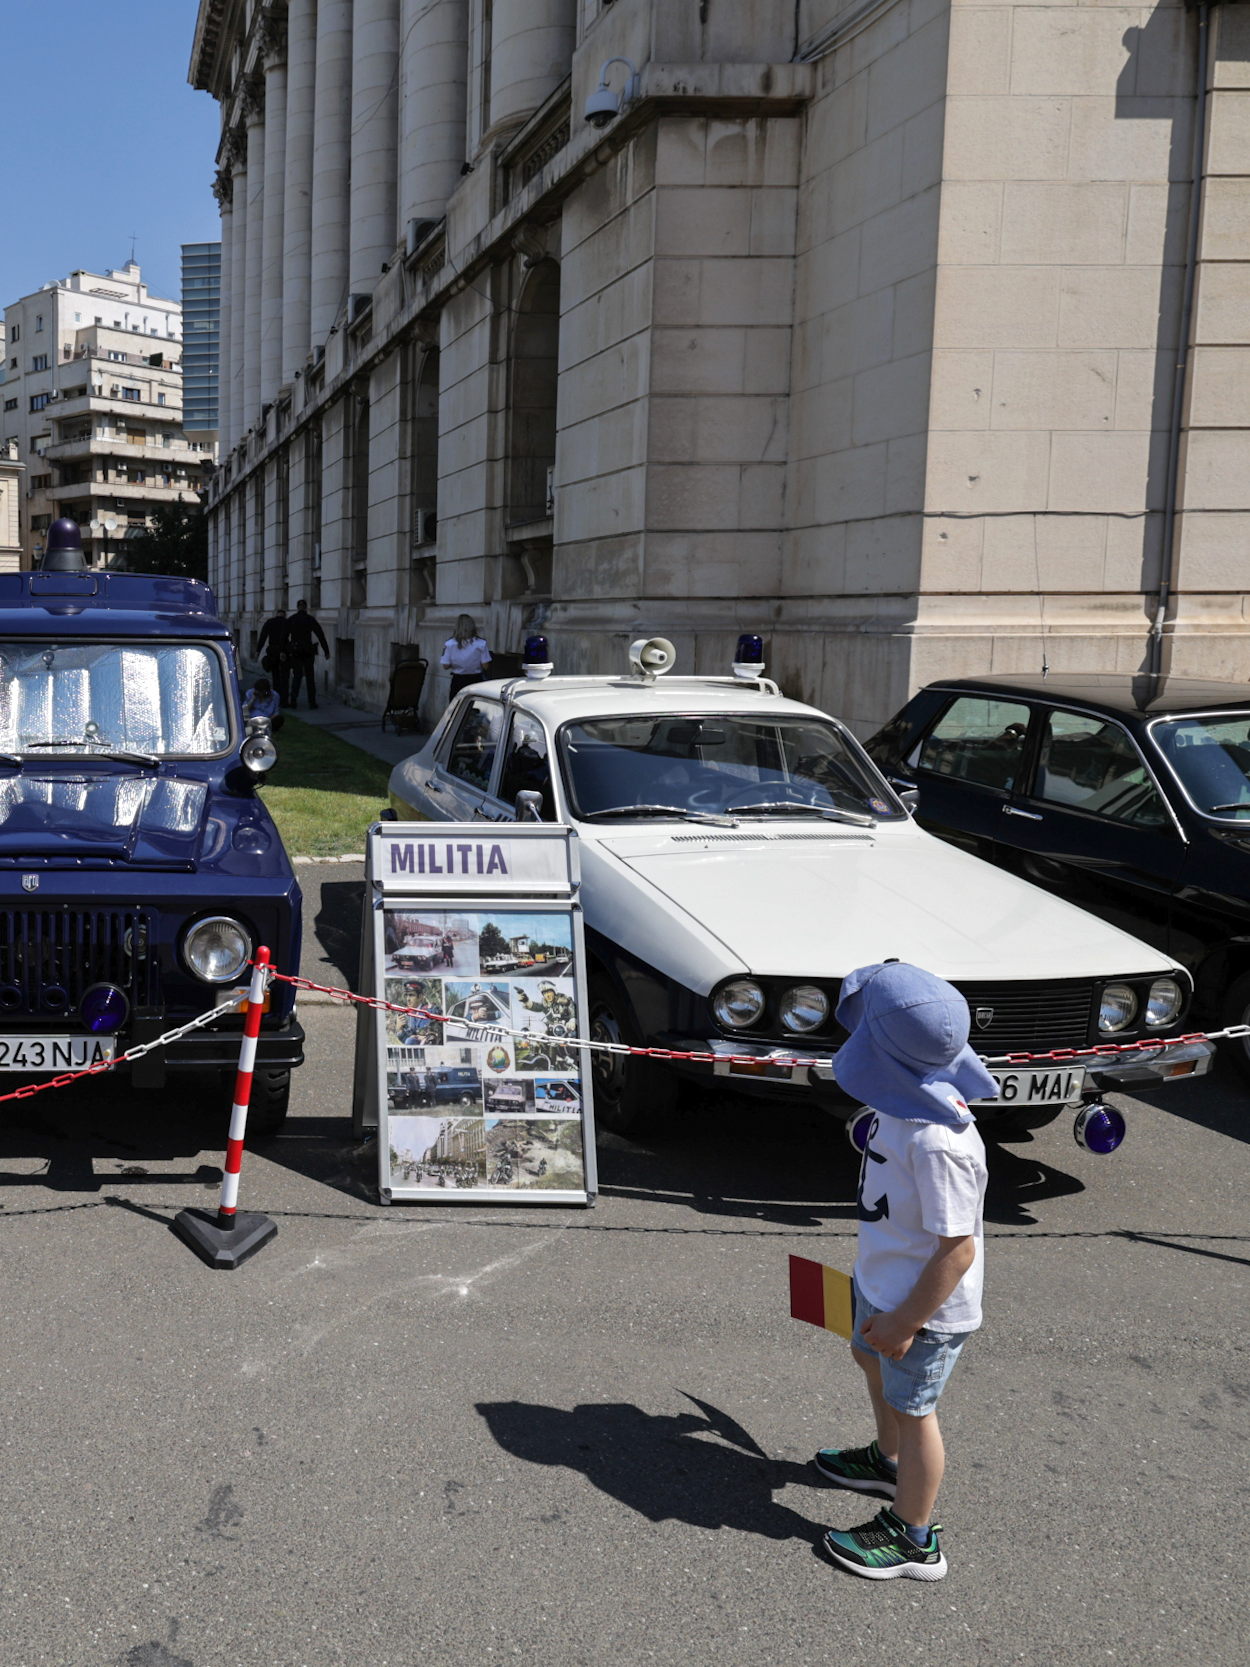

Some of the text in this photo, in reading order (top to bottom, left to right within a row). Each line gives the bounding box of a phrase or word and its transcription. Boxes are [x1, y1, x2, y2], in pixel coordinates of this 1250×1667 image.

[390, 843, 509, 875] MILITIA
[52, 1041, 108, 1067] NJA
[1027, 1072, 1073, 1101] MAI
